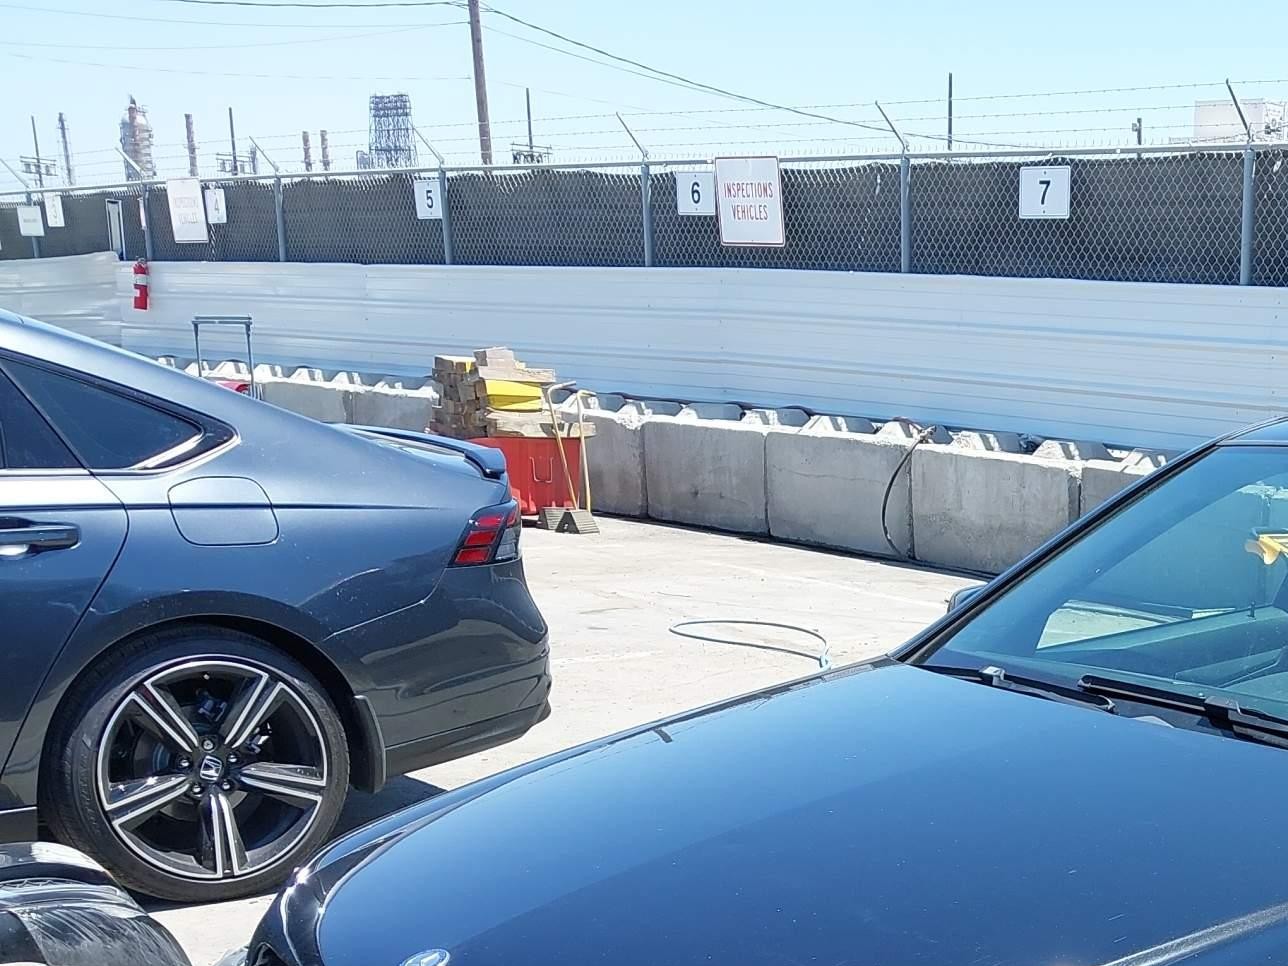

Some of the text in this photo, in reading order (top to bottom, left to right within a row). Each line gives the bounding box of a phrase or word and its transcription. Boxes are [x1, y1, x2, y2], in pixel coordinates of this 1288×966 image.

[425, 189, 434, 209] 5
[691, 181, 701, 205] 6
[723, 181, 774, 199] INSPECTIONS
[1038, 180, 1051, 205] 7
[731, 203, 769, 221] VEHICLES
